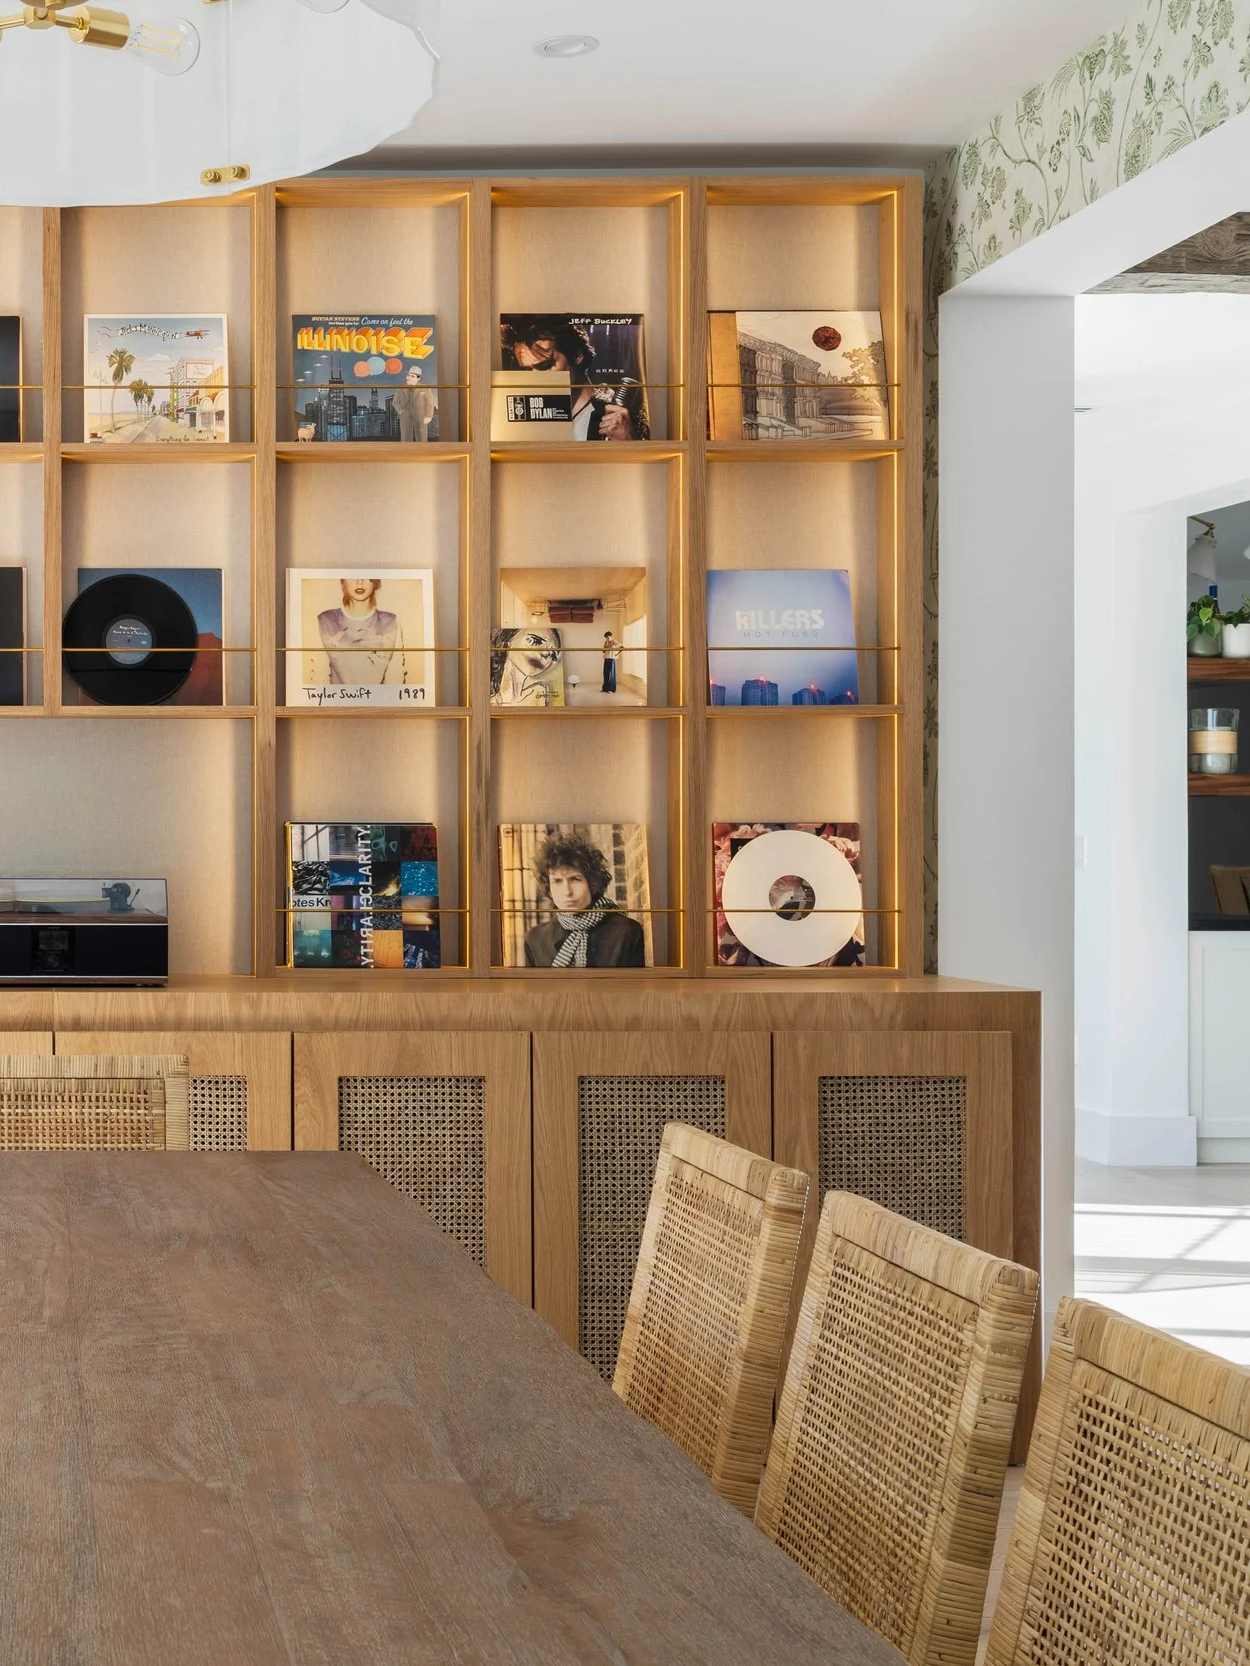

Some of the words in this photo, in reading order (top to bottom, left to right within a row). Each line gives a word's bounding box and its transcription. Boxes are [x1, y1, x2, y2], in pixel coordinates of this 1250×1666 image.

[361, 316, 379, 326] Come
[389, 317, 403, 327] feel
[297, 327, 434, 360] ILLINOISE
[530, 397, 543, 408] BOB
[530, 408, 552, 419] DYLAN
[735, 609, 825, 630] KILLERS
[302, 688, 337, 706] Taylor
[340, 687, 372, 699] Swift
[398, 688, 425, 700] 1989
